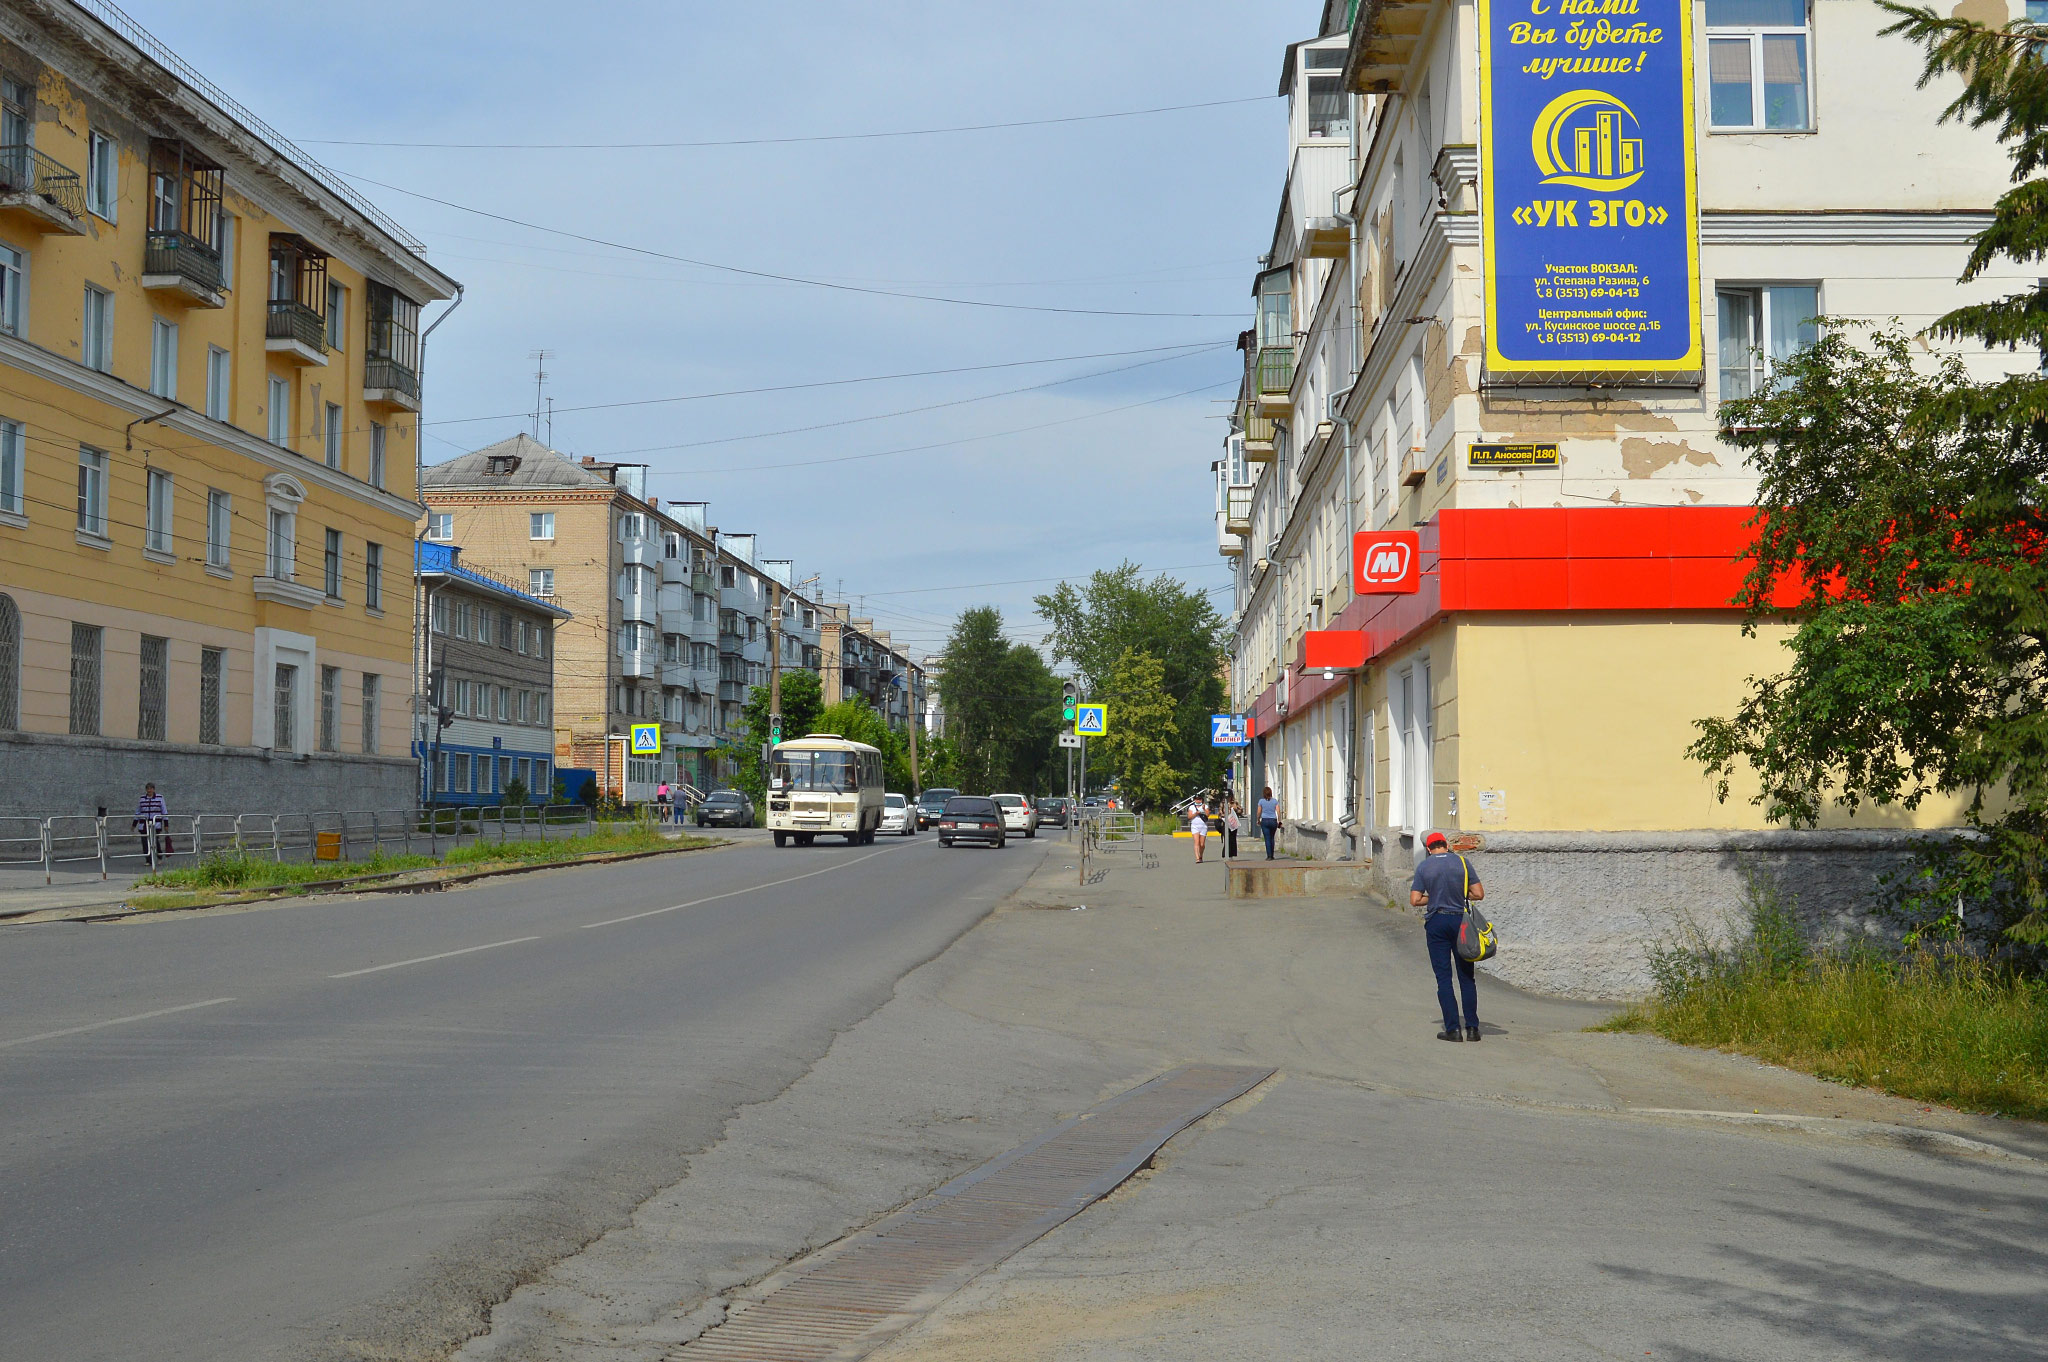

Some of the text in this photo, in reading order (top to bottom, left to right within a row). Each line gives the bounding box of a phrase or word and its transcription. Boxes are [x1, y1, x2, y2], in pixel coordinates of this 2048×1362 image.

[1531, 0, 1640, 15] С нами
[1508, 18, 1663, 50] Вы будете
[1522, 51, 1647, 80] лучшие!
[1511, 200, 1669, 227] «УК ЗГО»
[1545, 264, 1638, 274] Участок ВОКЗАЛ:
[1534, 276, 1650, 288] ул. Степана Разина, 6
[1545, 287, 1640, 299] 8 (3513) 69-04-13
[1538, 308, 1648, 320] Центральный офис:
[1525, 320, 1661, 333] ул. Кусинское шоссе д.1Б
[1546, 332, 1641, 344] 8 (3513) 69-04-12
[1473, 449, 1555, 459] П.П. Аносова 180
